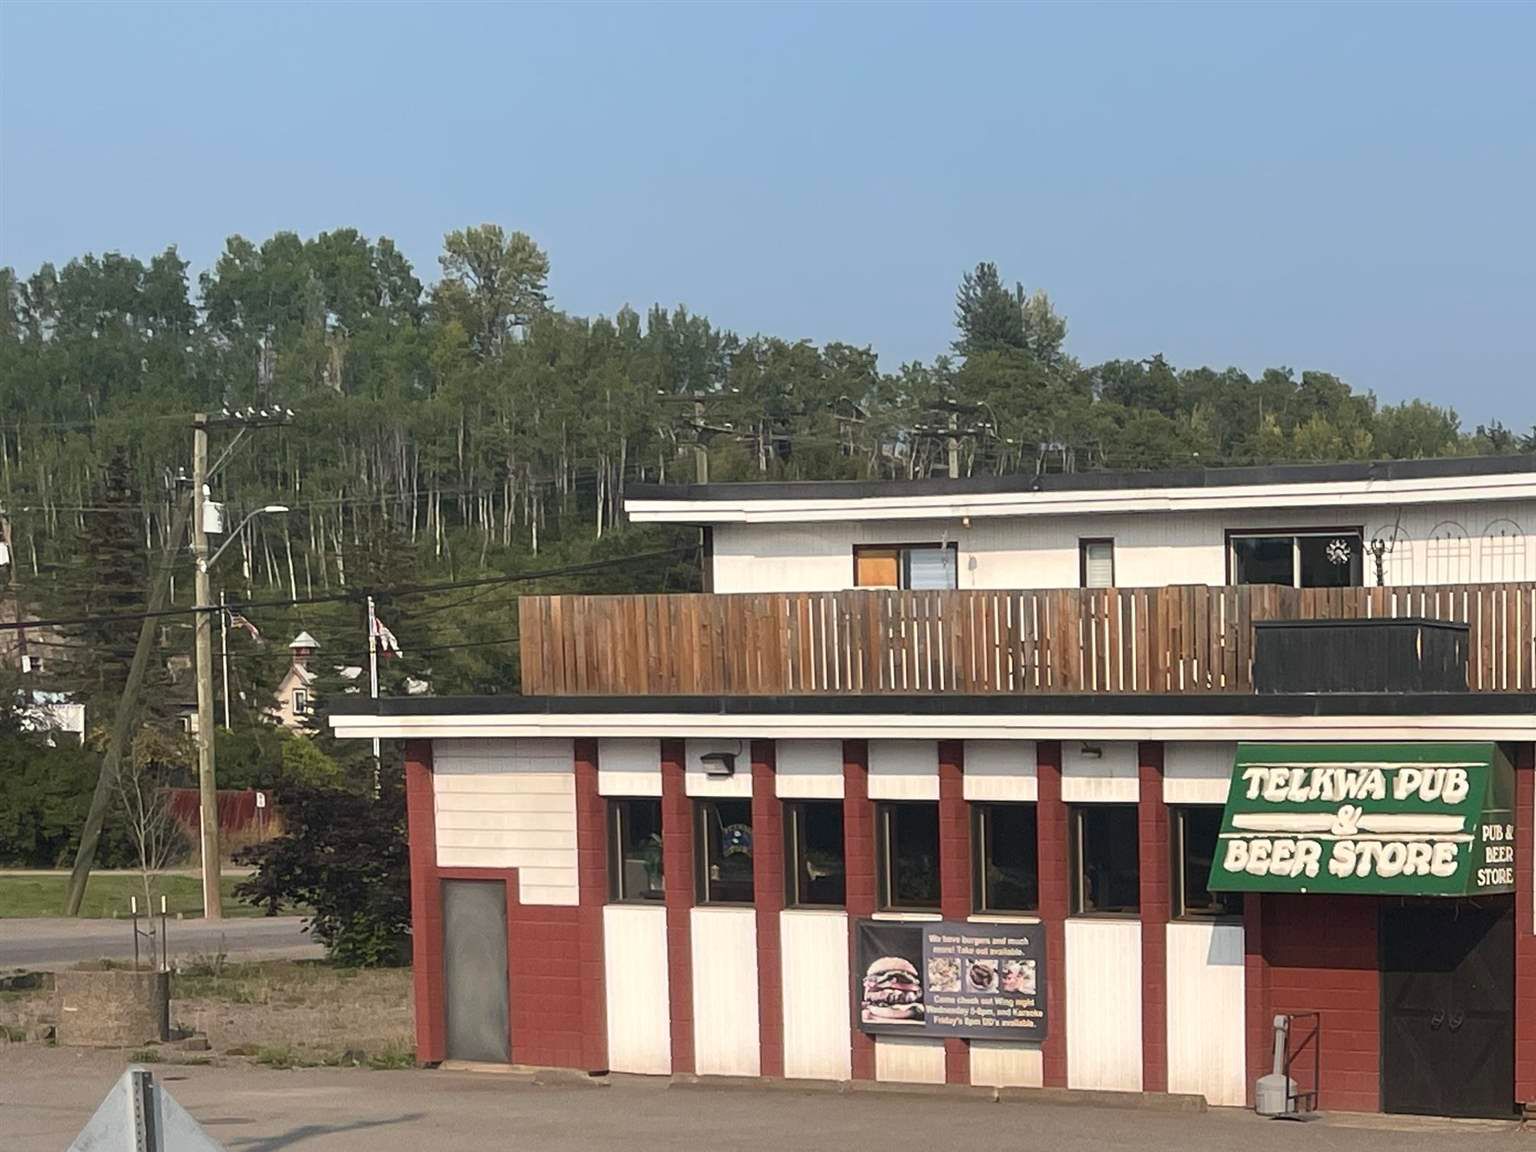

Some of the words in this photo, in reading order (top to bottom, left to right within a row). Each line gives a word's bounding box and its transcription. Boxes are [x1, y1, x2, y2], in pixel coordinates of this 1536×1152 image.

[1242, 766, 1386, 803] TELKWA
[1393, 767, 1469, 804] PUB
[1332, 804, 1362, 836] &
[1482, 825, 1503, 841] PUB
[1505, 823, 1514, 840] &
[1224, 838, 1322, 878] BEER
[1328, 839, 1459, 878] STORE
[1485, 846, 1514, 864] BEER
[1477, 867, 1514, 886] STORE
